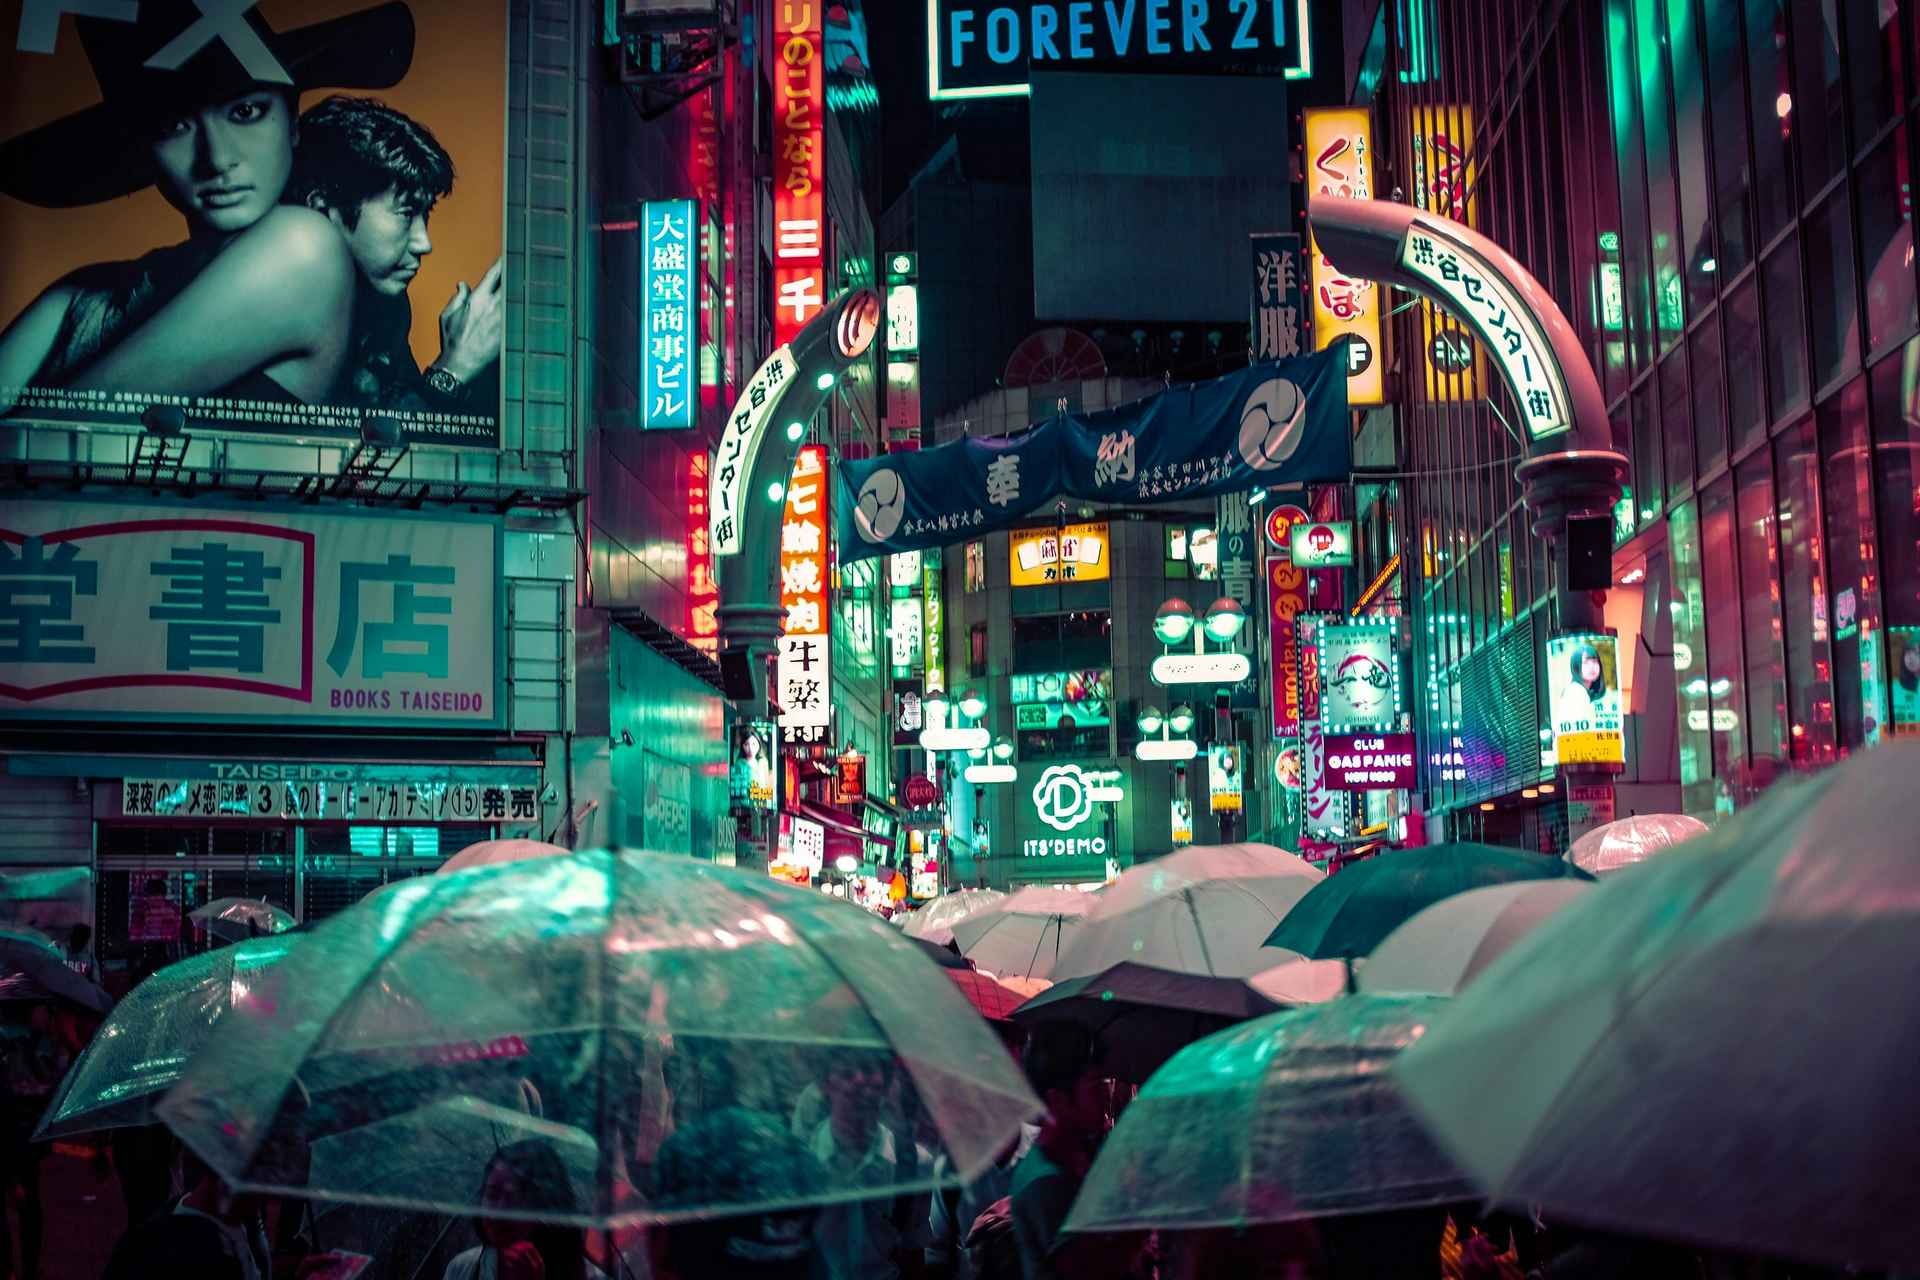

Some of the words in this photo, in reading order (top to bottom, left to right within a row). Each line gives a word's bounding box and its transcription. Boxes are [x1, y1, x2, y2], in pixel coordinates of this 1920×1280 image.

[949, 0, 1211, 67] FOREVER
[1229, 0, 1286, 50] 21
[651, 213, 686, 417] 大盛堂商事ビル
[1257, 250, 1300, 358] 洋服
[1412, 236, 1553, 420] 渋谷センター街
[715, 359, 784, 548] 渋谷センター街
[330, 688, 391, 710] BOOKS
[401, 690, 483, 713] TAISEIDO
[787, 640, 820, 711] 牛繁
[209, 763, 353, 780] TAISEIDO
[1306, 724, 1331, 820] ラーメン
[1328, 755, 1362, 769] GAS
[1363, 753, 1412, 768] PANIC
[1354, 738, 1385, 751] CLUB
[717, 815, 737, 849] BOSS
[1023, 837, 1106, 858] ITS'DEMO
